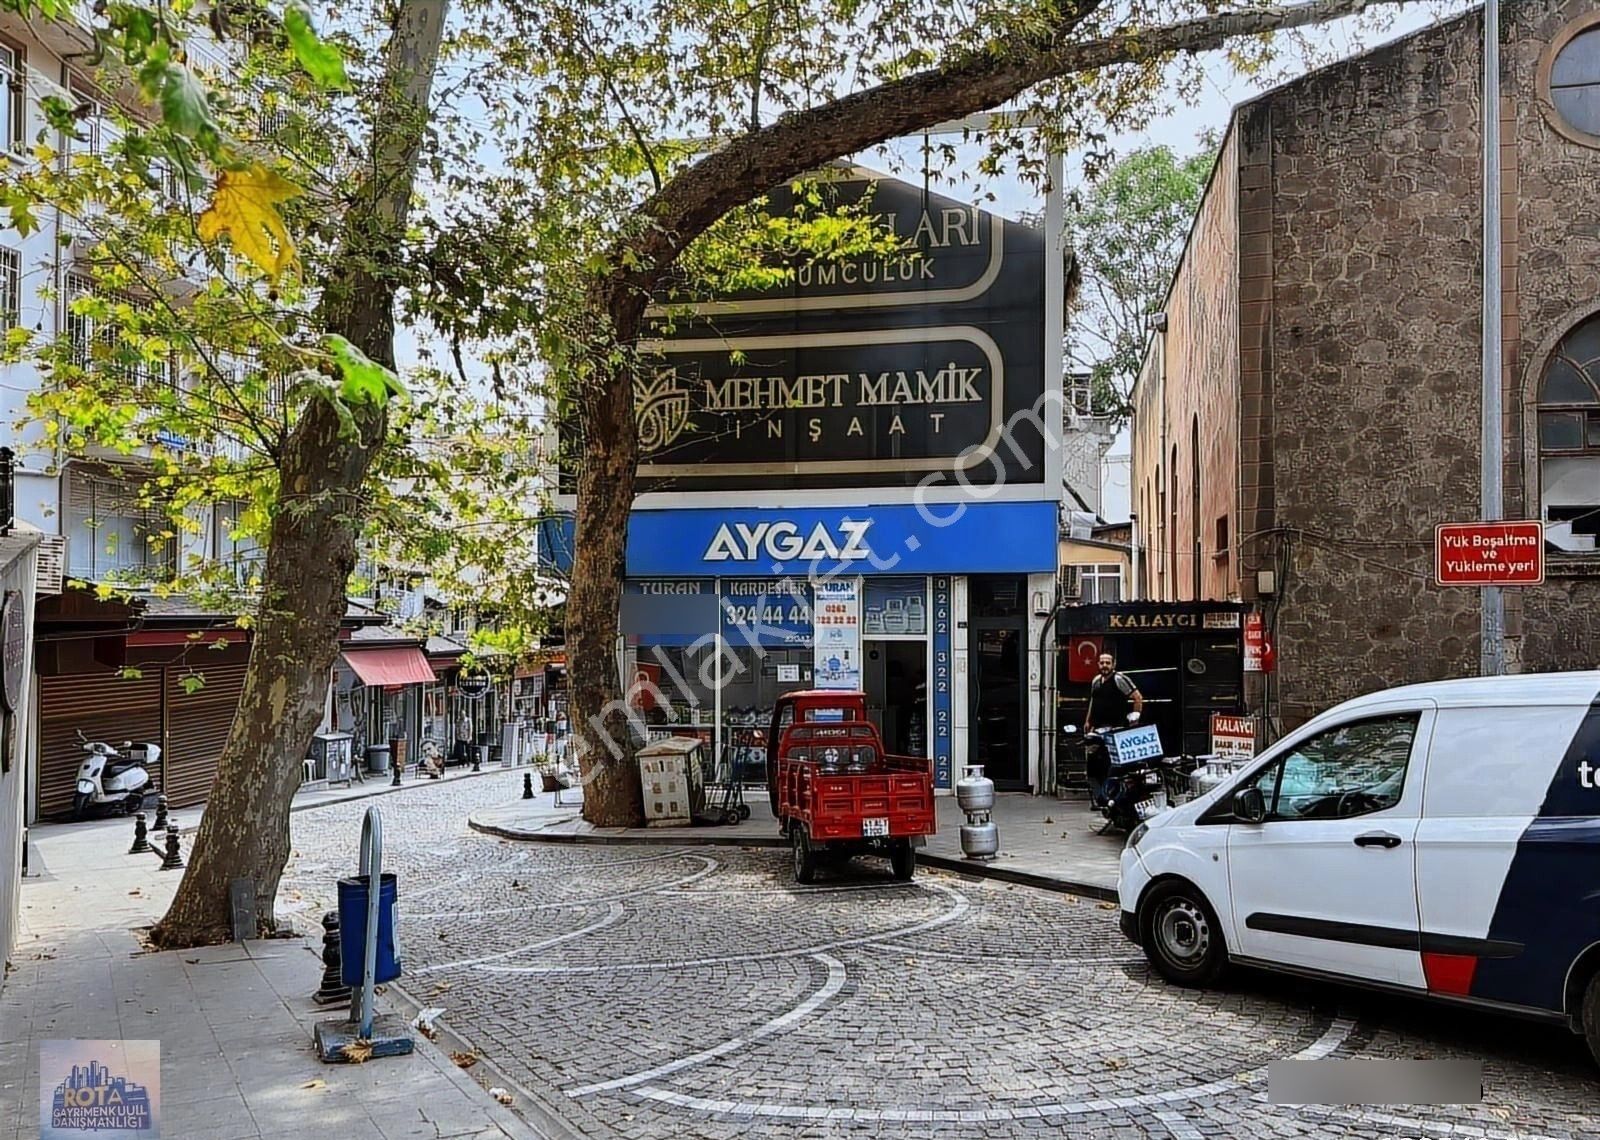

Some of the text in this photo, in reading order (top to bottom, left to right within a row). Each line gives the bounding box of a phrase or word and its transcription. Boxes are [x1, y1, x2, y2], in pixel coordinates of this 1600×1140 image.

[704, 362, 983, 410] MEHMET MAMİK
[703, 521, 871, 561] AYGAZ
[1443, 533, 1537, 549] Yük Boşaltma
[1481, 550, 1498, 559] ve
[1446, 560, 1506, 573] Yükleme
[640, 582, 701, 595] TURAN
[730, 581, 807, 598] KARDEŞLER
[726, 604, 811, 625] 324 44 44
[1109, 613, 1197, 628] KALAYCI
[1216, 718, 1254, 735] KALAYCI
[1119, 732, 1158, 749] AYGAZ
